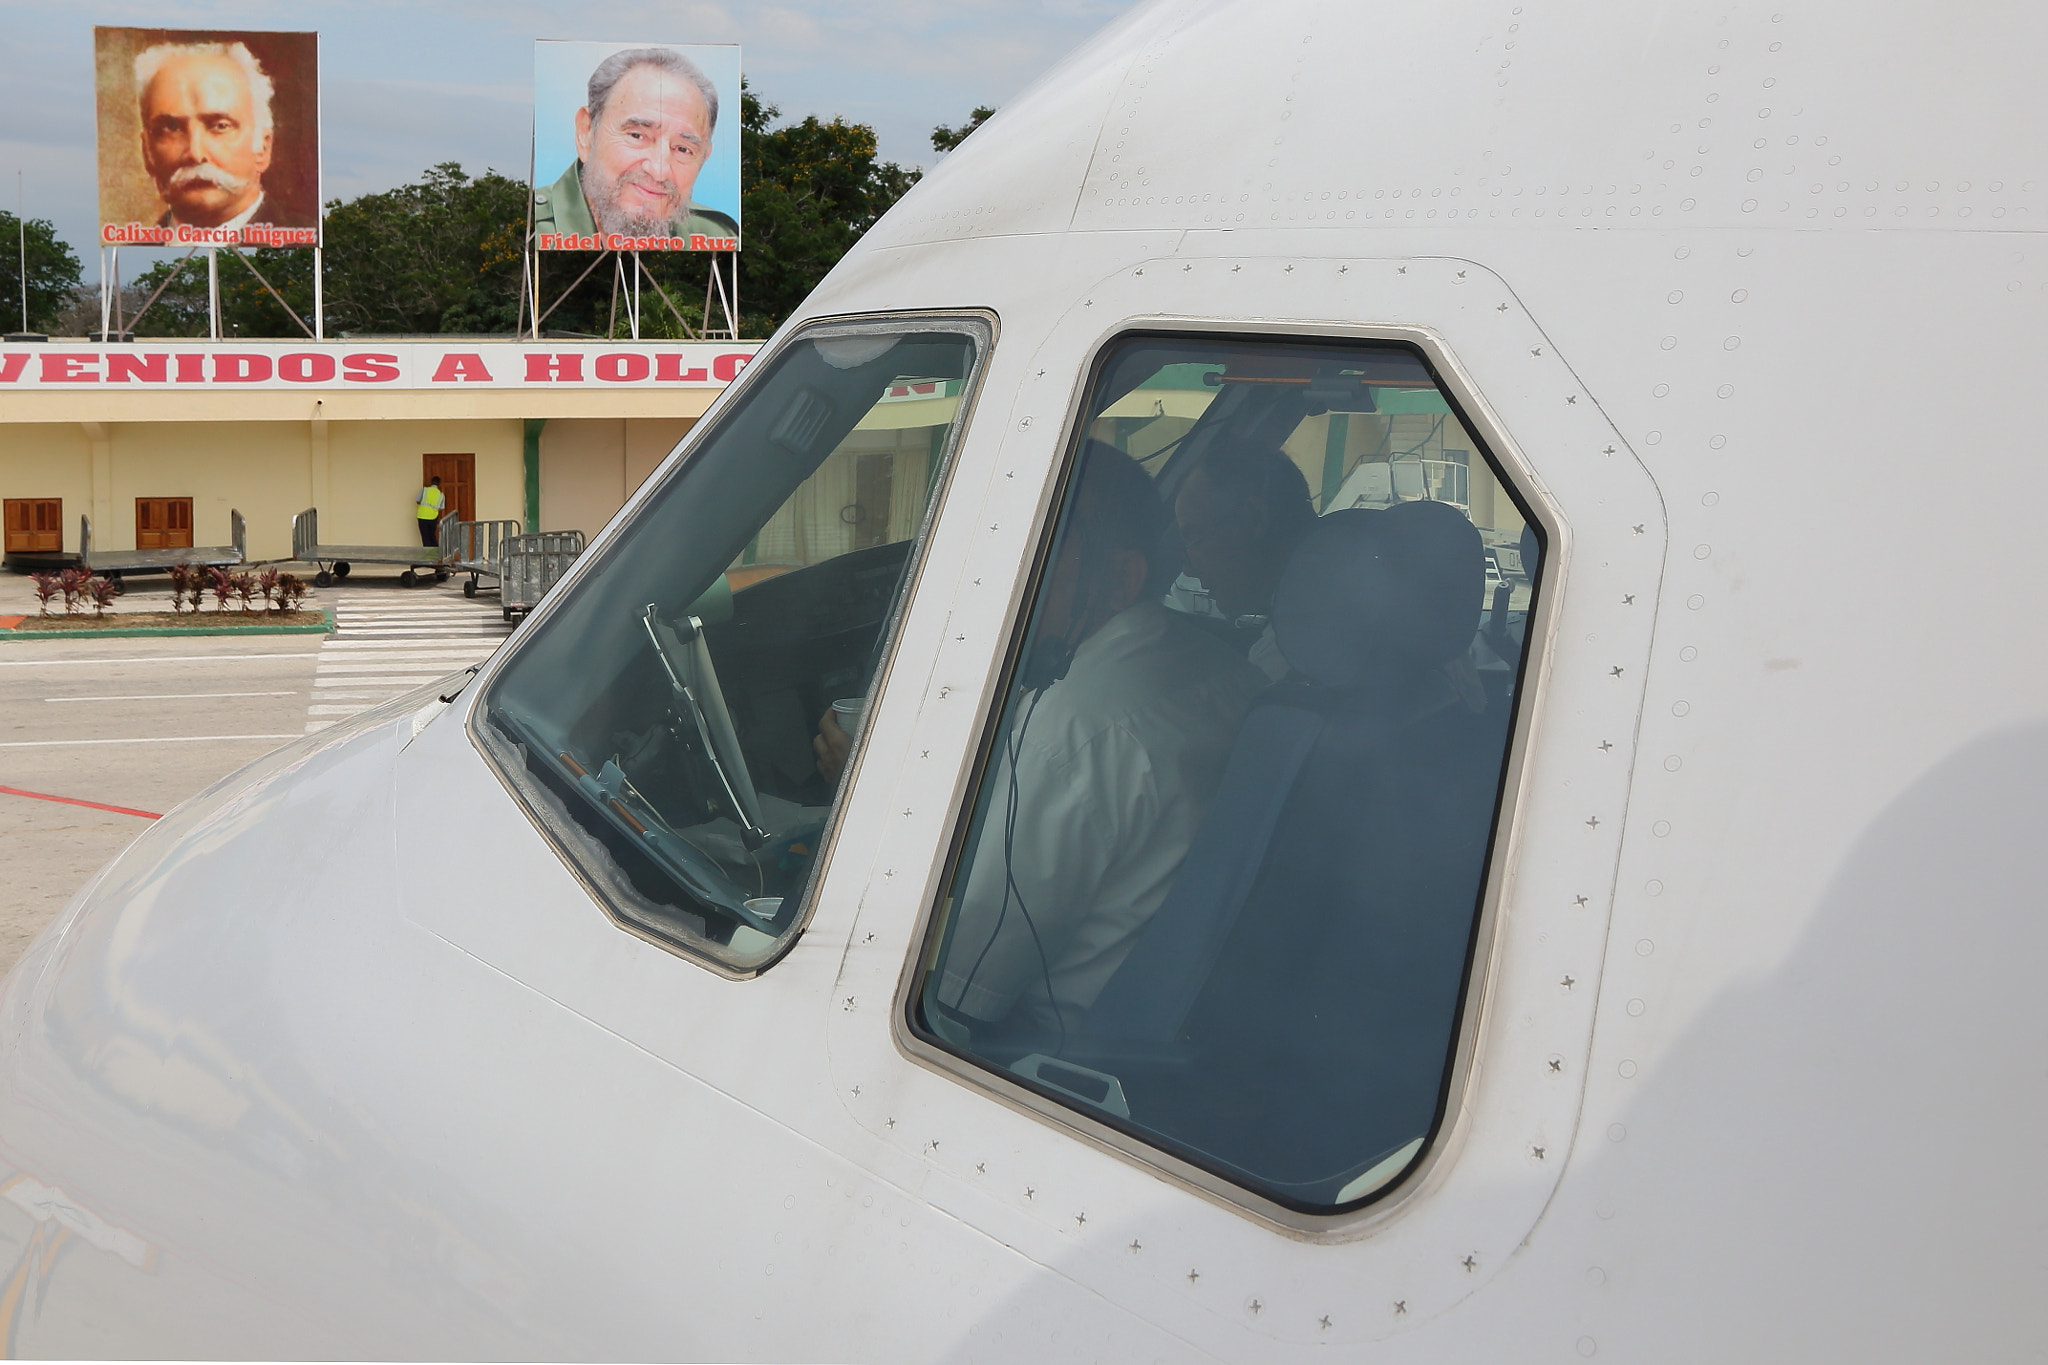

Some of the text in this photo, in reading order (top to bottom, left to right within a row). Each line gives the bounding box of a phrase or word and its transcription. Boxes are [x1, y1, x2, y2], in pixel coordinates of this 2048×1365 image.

[103, 223, 174, 243] Calixto
[539, 233, 737, 251] Fidel Castro Ruz
[431, 353, 494, 382] A
